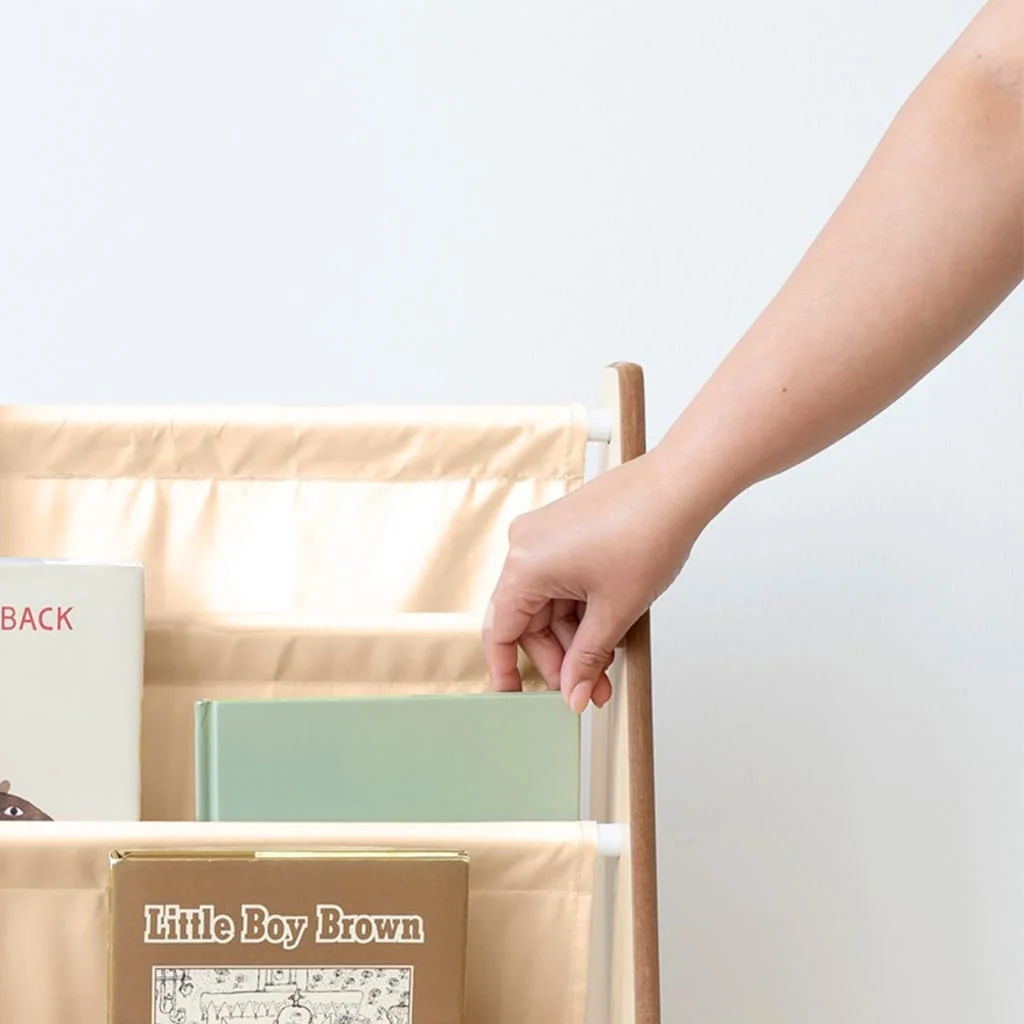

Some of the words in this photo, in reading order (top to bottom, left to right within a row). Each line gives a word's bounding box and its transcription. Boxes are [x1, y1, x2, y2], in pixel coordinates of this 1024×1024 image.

[1, 606, 72, 631] BACK
[144, 904, 235, 943] Little
[241, 904, 308, 950] Boy
[315, 904, 424, 944] Brown
